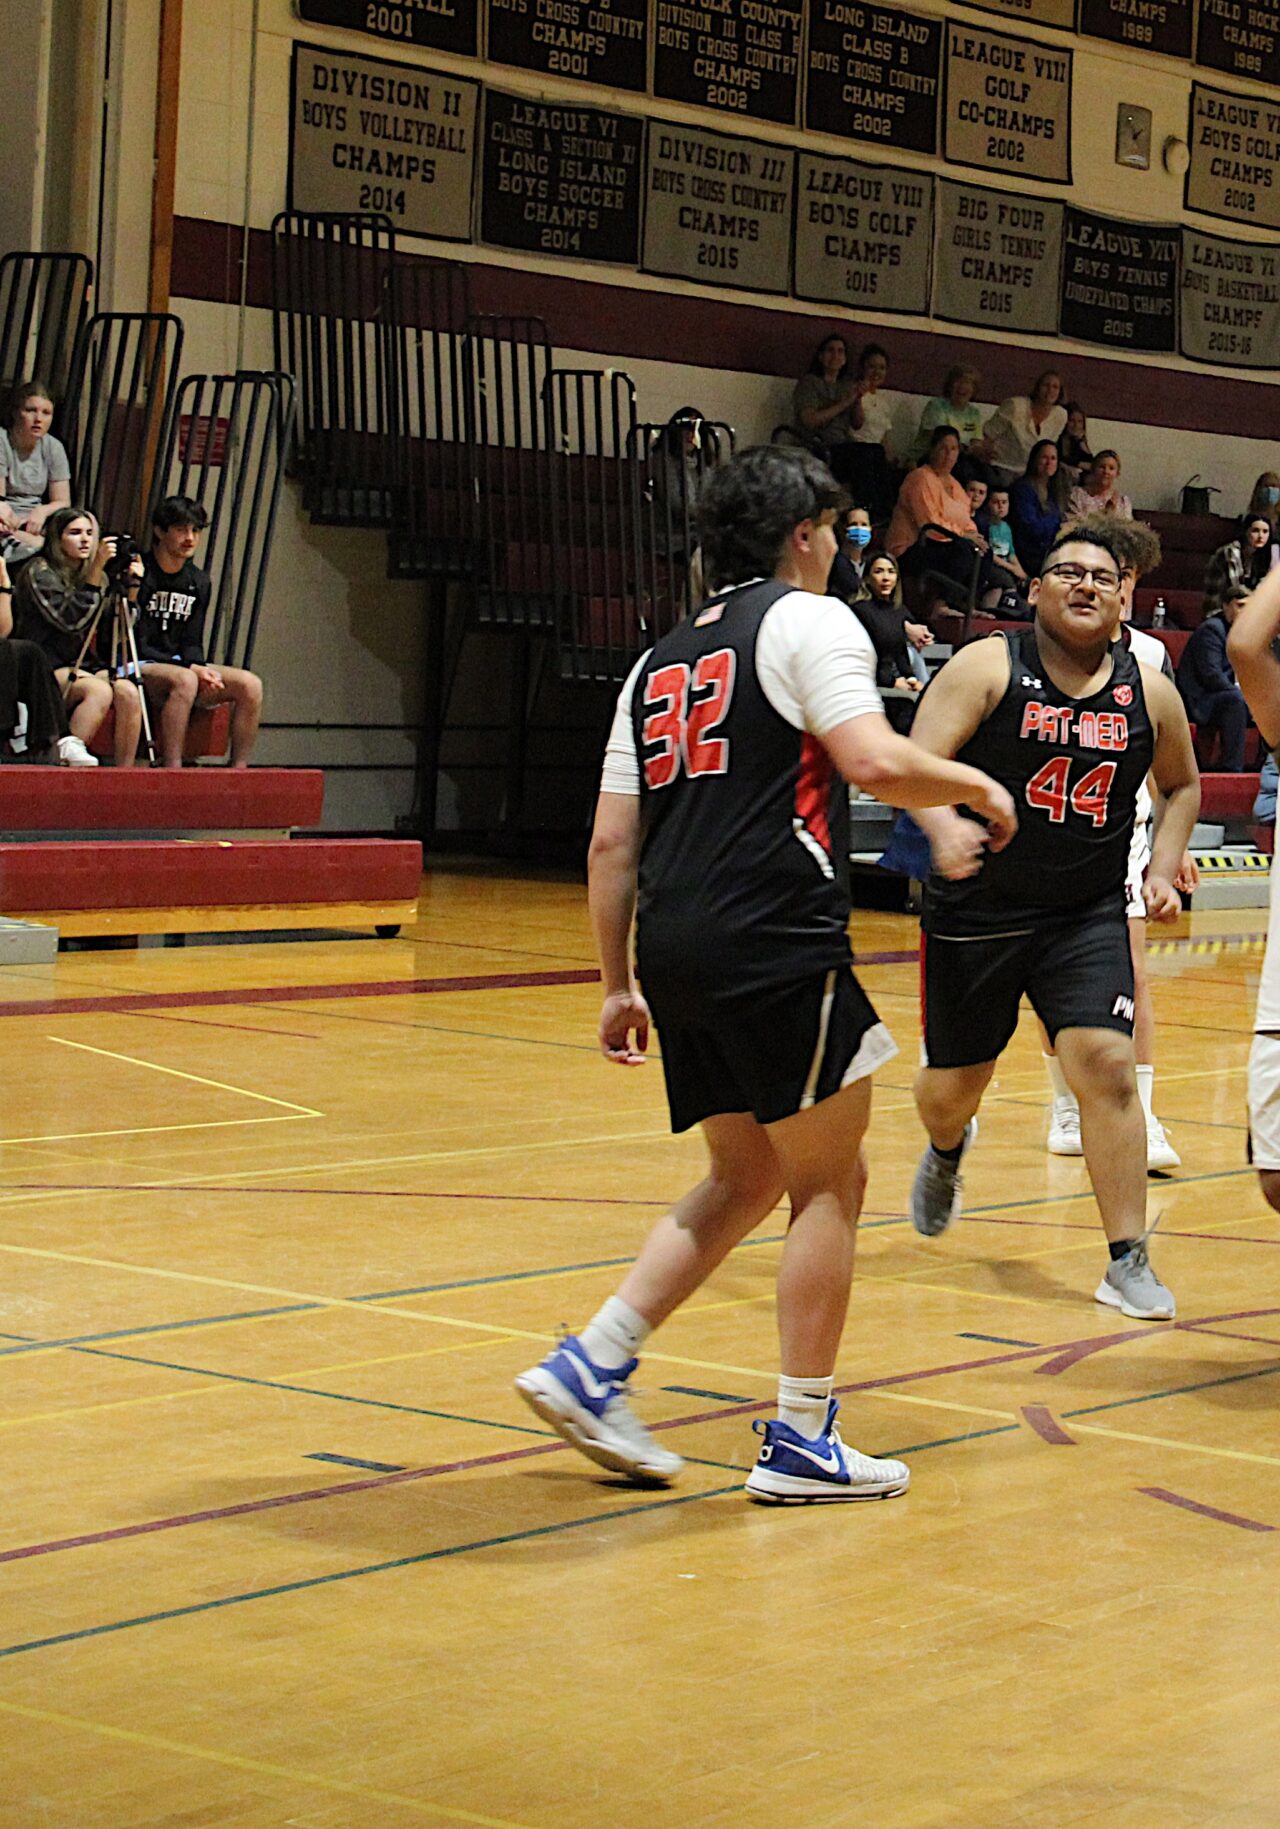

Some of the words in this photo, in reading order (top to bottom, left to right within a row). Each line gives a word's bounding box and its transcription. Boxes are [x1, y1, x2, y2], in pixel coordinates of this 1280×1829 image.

[366, 3, 413, 37] 2001
[536, 0, 580, 25] CROSS
[588, 10, 644, 40] COUNTRY
[659, 3, 712, 33] DIVISION
[723, 18, 736, 38] III
[746, 24, 782, 50] CLASS
[740, 0, 801, 31] COUNTY
[824, 1, 865, 28] LONG
[872, 14, 930, 44] ISLAND
[532, 22, 606, 56] CHAMPS
[842, 33, 893, 60] CLASS
[1122, 21, 1153, 42] 1989
[1223, 25, 1274, 53] CHAMPS
[548, 50, 588, 75] 2001
[659, 26, 689, 50] BOYS
[698, 36, 739, 62] CROSS
[745, 47, 797, 75] COUNTRY
[951, 36, 1026, 72] LEAGUE
[1034, 56, 1067, 83] VIII
[694, 59, 762, 90] CHAMPS
[810, 50, 840, 73] BOYS
[847, 59, 883, 83] CROSS
[889, 69, 937, 96] COUNTRY
[313, 64, 430, 111] DIVISION
[443, 91, 462, 117] II
[707, 85, 748, 110] 2002
[842, 84, 906, 114] CHAMPS
[985, 75, 1031, 103] GOLF
[302, 99, 347, 131] BOYS
[360, 110, 466, 154] VOLLEYBALL
[510, 103, 590, 133] LEAGUE
[598, 117, 618, 138] VI
[853, 112, 892, 136] 2002
[958, 100, 1056, 139] CO-CHAMPS
[1196, 98, 1260, 129] LEAGUE
[491, 121, 534, 149] CLASS
[986, 136, 1026, 162] 2002
[1200, 126, 1241, 153] BOYS
[332, 143, 436, 183] CHAMPS
[498, 148, 549, 174] LONG
[559, 158, 627, 186] ISLAND
[658, 135, 751, 176] DIVISION
[759, 157, 786, 183] III
[1210, 157, 1273, 187] CHAMPS
[359, 184, 406, 215] 2014
[498, 172, 549, 199] BOYS
[558, 183, 625, 209] SOCCER
[652, 167, 686, 196] BOYS
[691, 175, 728, 205] CROSS
[731, 183, 788, 215] COUNTRY
[806, 169, 884, 203] LEAGUE
[891, 183, 923, 208] VIII
[1224, 187, 1256, 212] 2002
[523, 201, 599, 230] CHAMPS
[678, 206, 760, 242] CHAMPS
[868, 211, 917, 237] GOLF
[957, 196, 989, 221] BIG
[997, 203, 1045, 232] FOUR
[540, 228, 581, 251] 2014
[952, 224, 992, 252] GIRLS
[1000, 234, 1046, 260] TENNIS
[1064, 221, 1143, 259] LEAGUE
[697, 242, 740, 270] 2015
[1073, 256, 1111, 279] BOYS
[1117, 265, 1170, 287] TENNIS
[1191, 244, 1255, 274] LEAGUE
[961, 256, 1034, 288] CHAMPS
[1182, 269, 1211, 294] BOYS
[979, 289, 1013, 314] 2015
[1065, 281, 1130, 311] UNDEFEATED
[1102, 319, 1134, 338] 2015
[1204, 302, 1264, 329] CHAMPS
[1207, 331, 1253, 356] 2015-16
[641, 647, 737, 790] 32
[1025, 755, 1118, 828] 44
